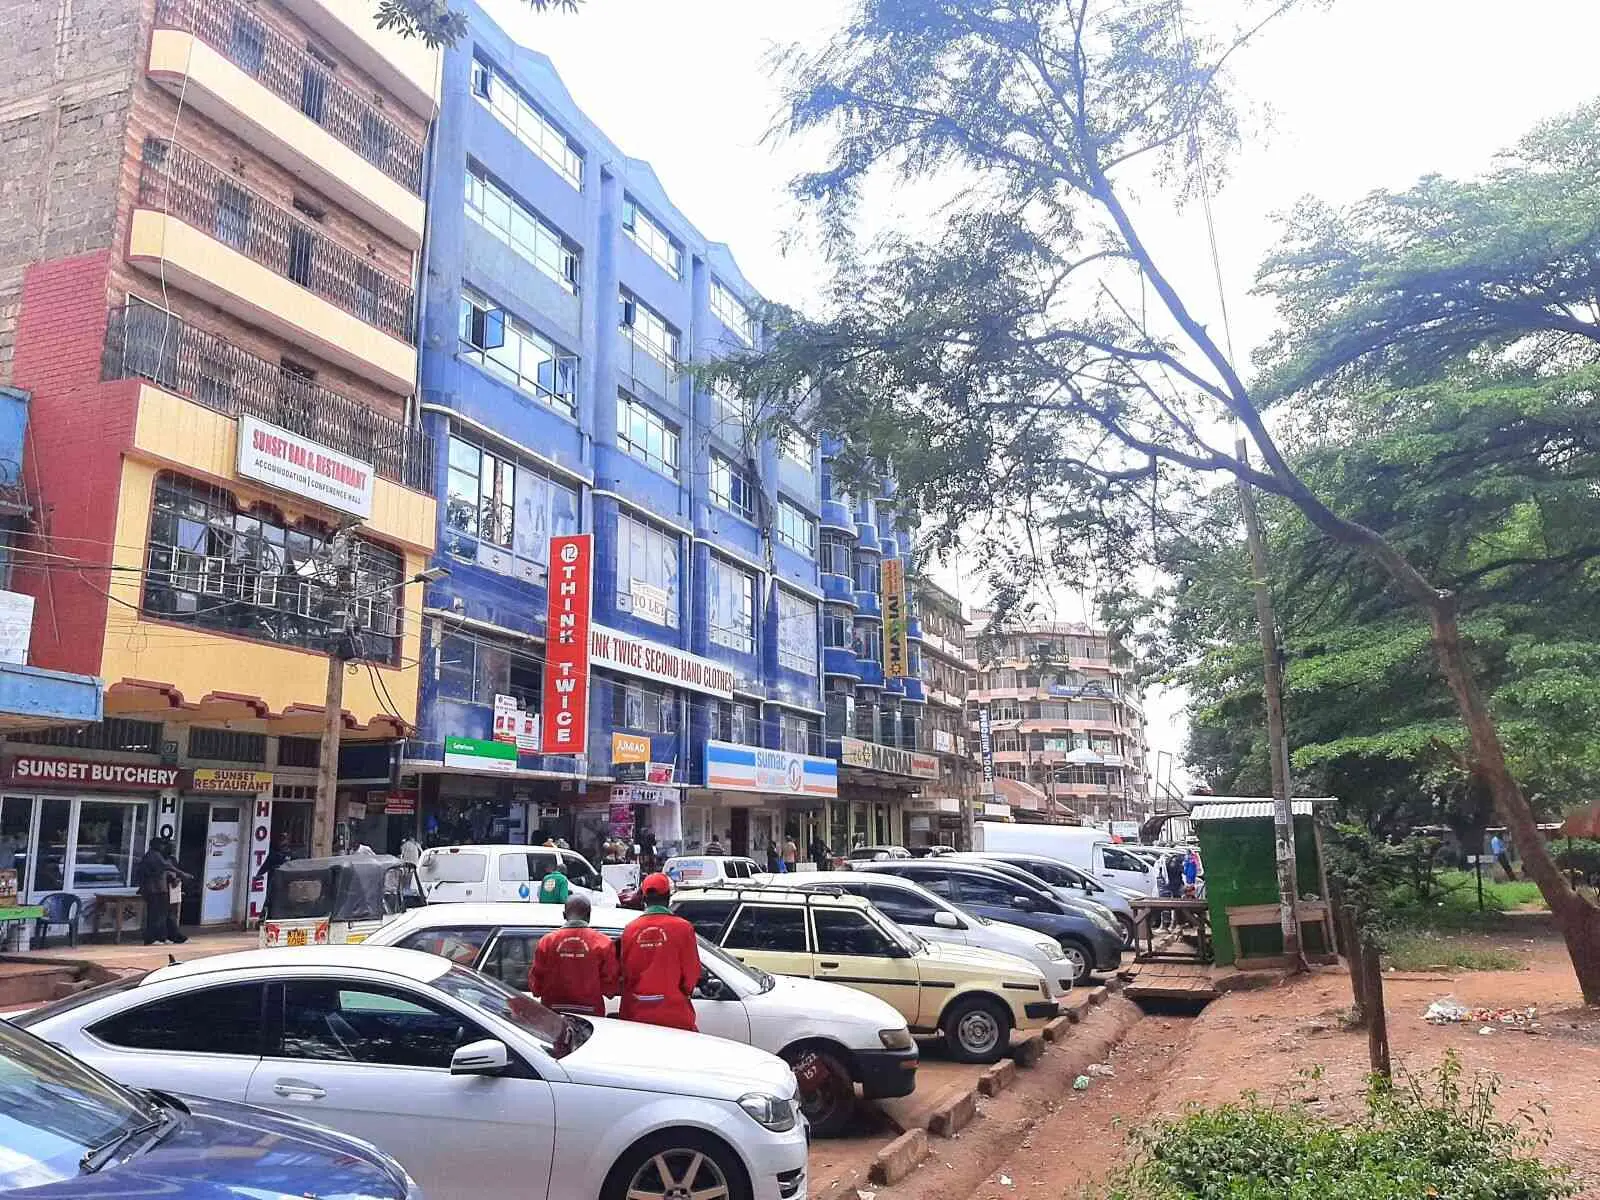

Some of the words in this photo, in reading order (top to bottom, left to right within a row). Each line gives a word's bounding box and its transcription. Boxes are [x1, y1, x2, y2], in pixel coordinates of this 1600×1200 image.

[253, 429, 289, 459] SUNSET
[288, 443, 306, 469] BAR
[307, 452, 315, 472] &
[315, 454, 367, 492] RESTAURANT
[560, 565, 576, 645] THINK
[634, 592, 646, 609] TO
[591, 631, 609, 660] INK
[613, 638, 642, 669] TWICE
[645, 647, 679, 679] SECOND
[680, 657, 702, 685] HAND
[703, 665, 732, 694] CLOTHES
[555, 662, 576, 743] TWICE
[17, 759, 89, 779] SUNSET
[91, 764, 178, 785] BUTCHERY
[757, 751, 786, 771] sumac
[983, 753, 993, 782] CHOOL
[195, 778, 271, 791] RESTAURANT
[214, 771, 256, 781] SUNSET
[247, 800, 270, 919] HOTEL
